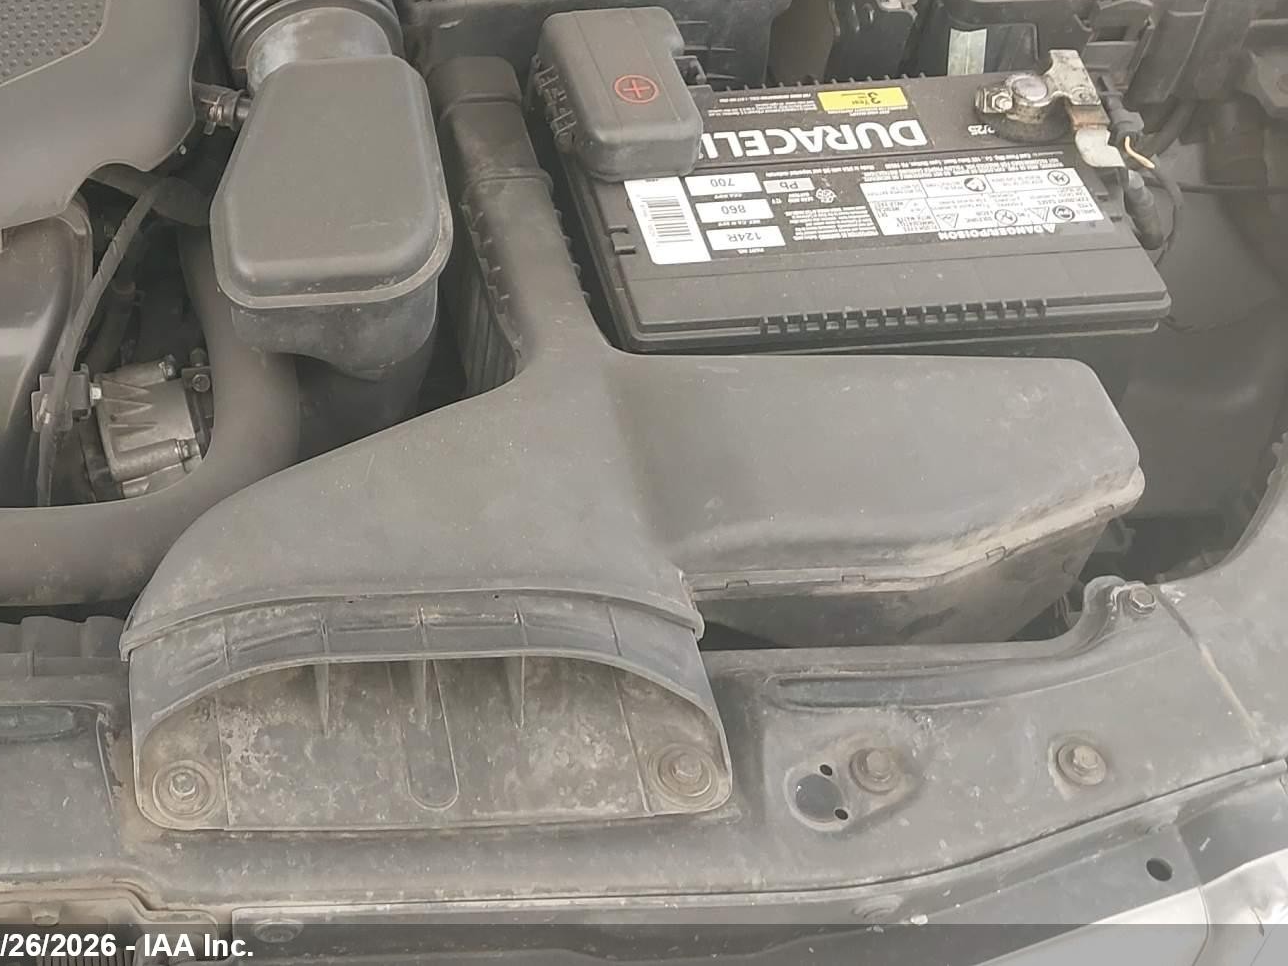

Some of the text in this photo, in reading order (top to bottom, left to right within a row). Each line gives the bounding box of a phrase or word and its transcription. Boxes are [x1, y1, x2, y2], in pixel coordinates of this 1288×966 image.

[866, 91, 881, 104] 3
[710, 177, 735, 188] 700
[720, 204, 746, 215] 860
[726, 232, 762, 243] 124R
